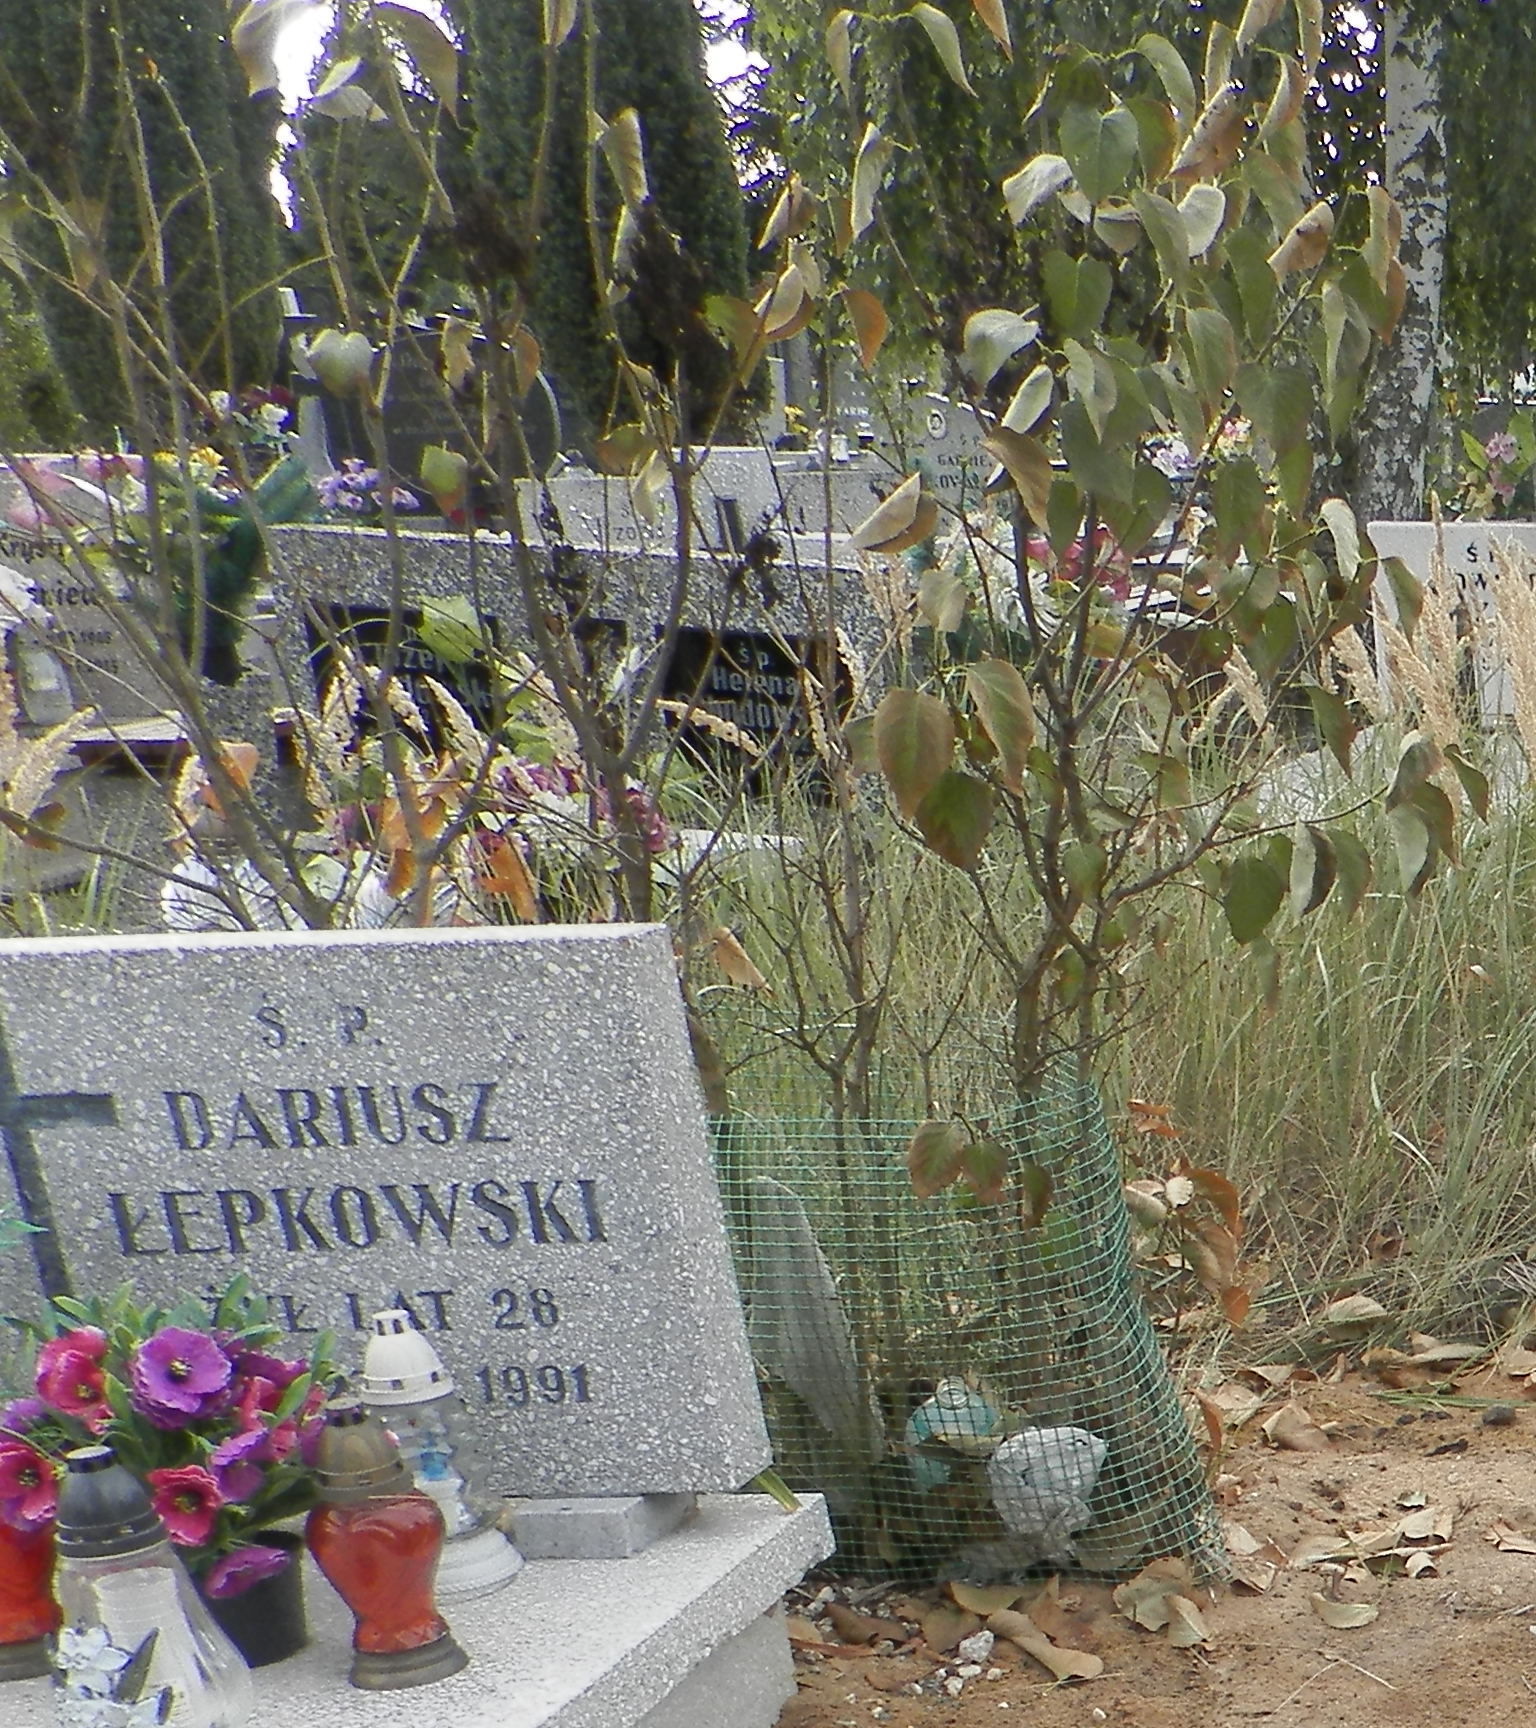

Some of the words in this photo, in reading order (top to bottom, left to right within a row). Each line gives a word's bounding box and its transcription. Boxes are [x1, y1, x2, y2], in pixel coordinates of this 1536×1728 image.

[161, 1081, 514, 1151] DARIUSZ
[106, 1178, 610, 1258] ŁEPKOWSKI
[491, 1286, 562, 1331] 28
[475, 1362, 594, 1406] 1991
